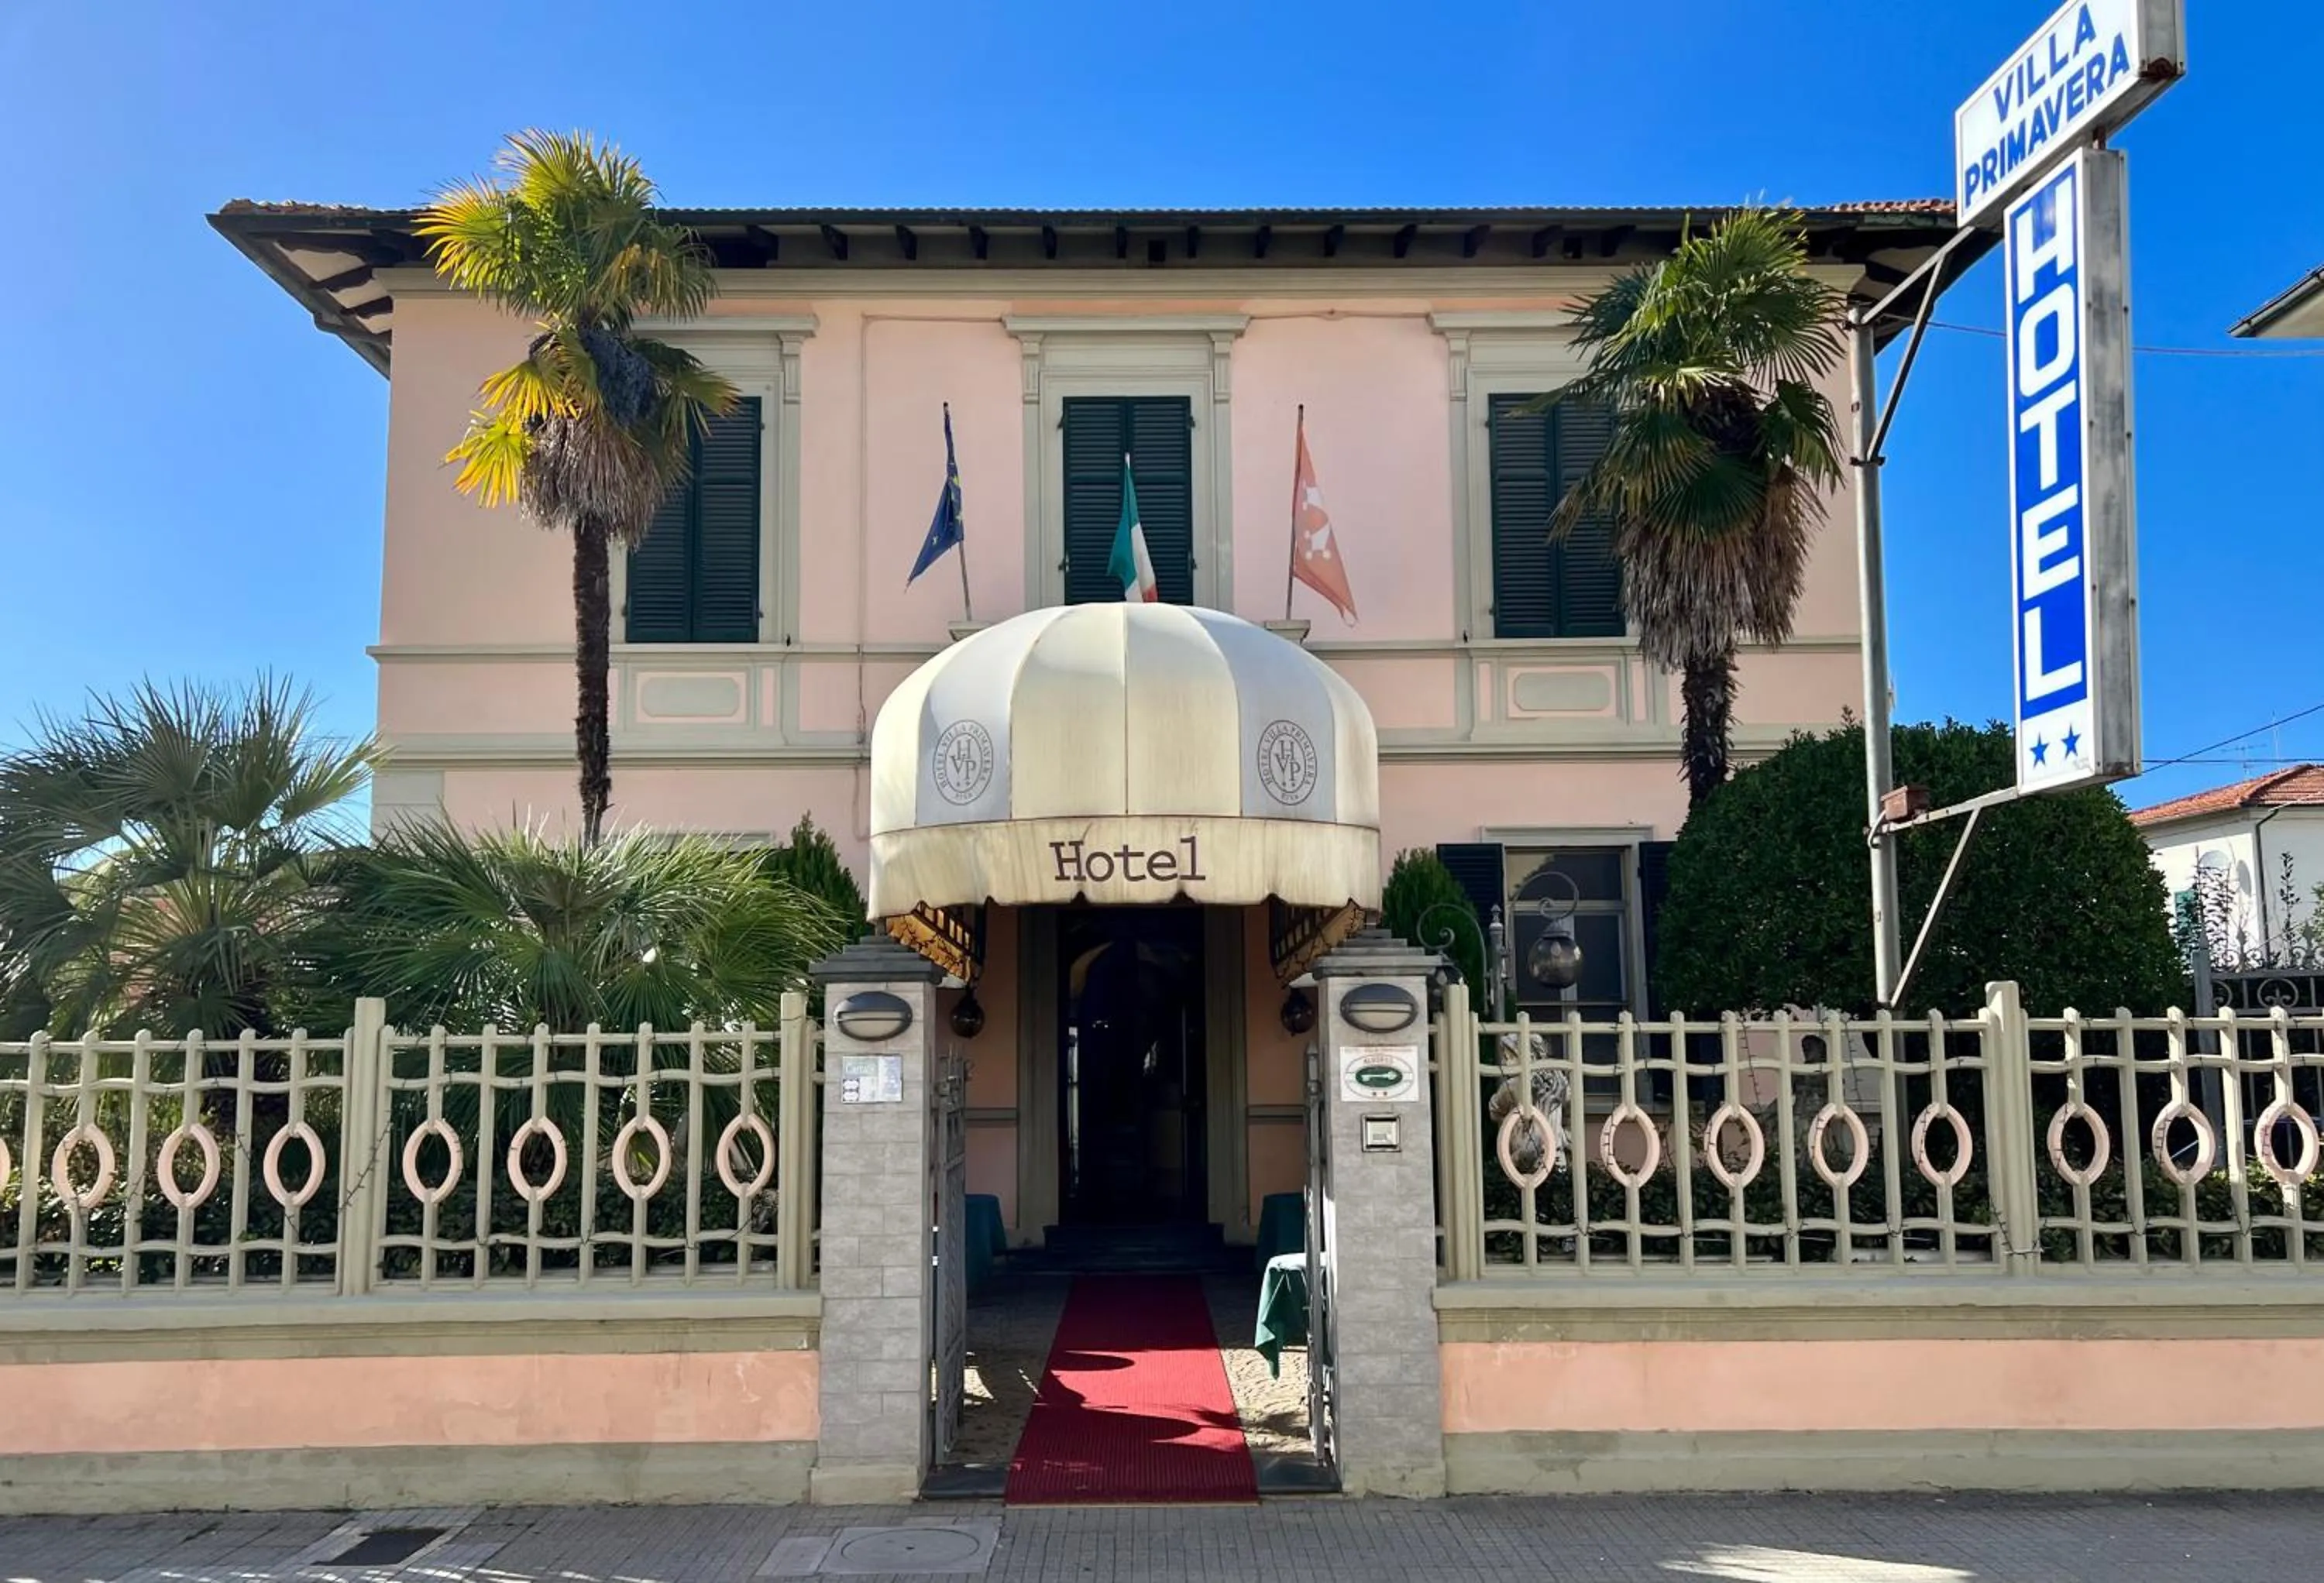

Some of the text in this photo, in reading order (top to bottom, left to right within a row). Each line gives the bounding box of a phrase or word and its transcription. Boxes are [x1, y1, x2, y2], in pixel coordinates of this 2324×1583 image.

[1965, 32, 2130, 209] PRIMAVERA
[1993, 3, 2097, 124] VILLA
[2015, 174, 2082, 702] HOTEL
[1049, 836, 1206, 881] Hotel
